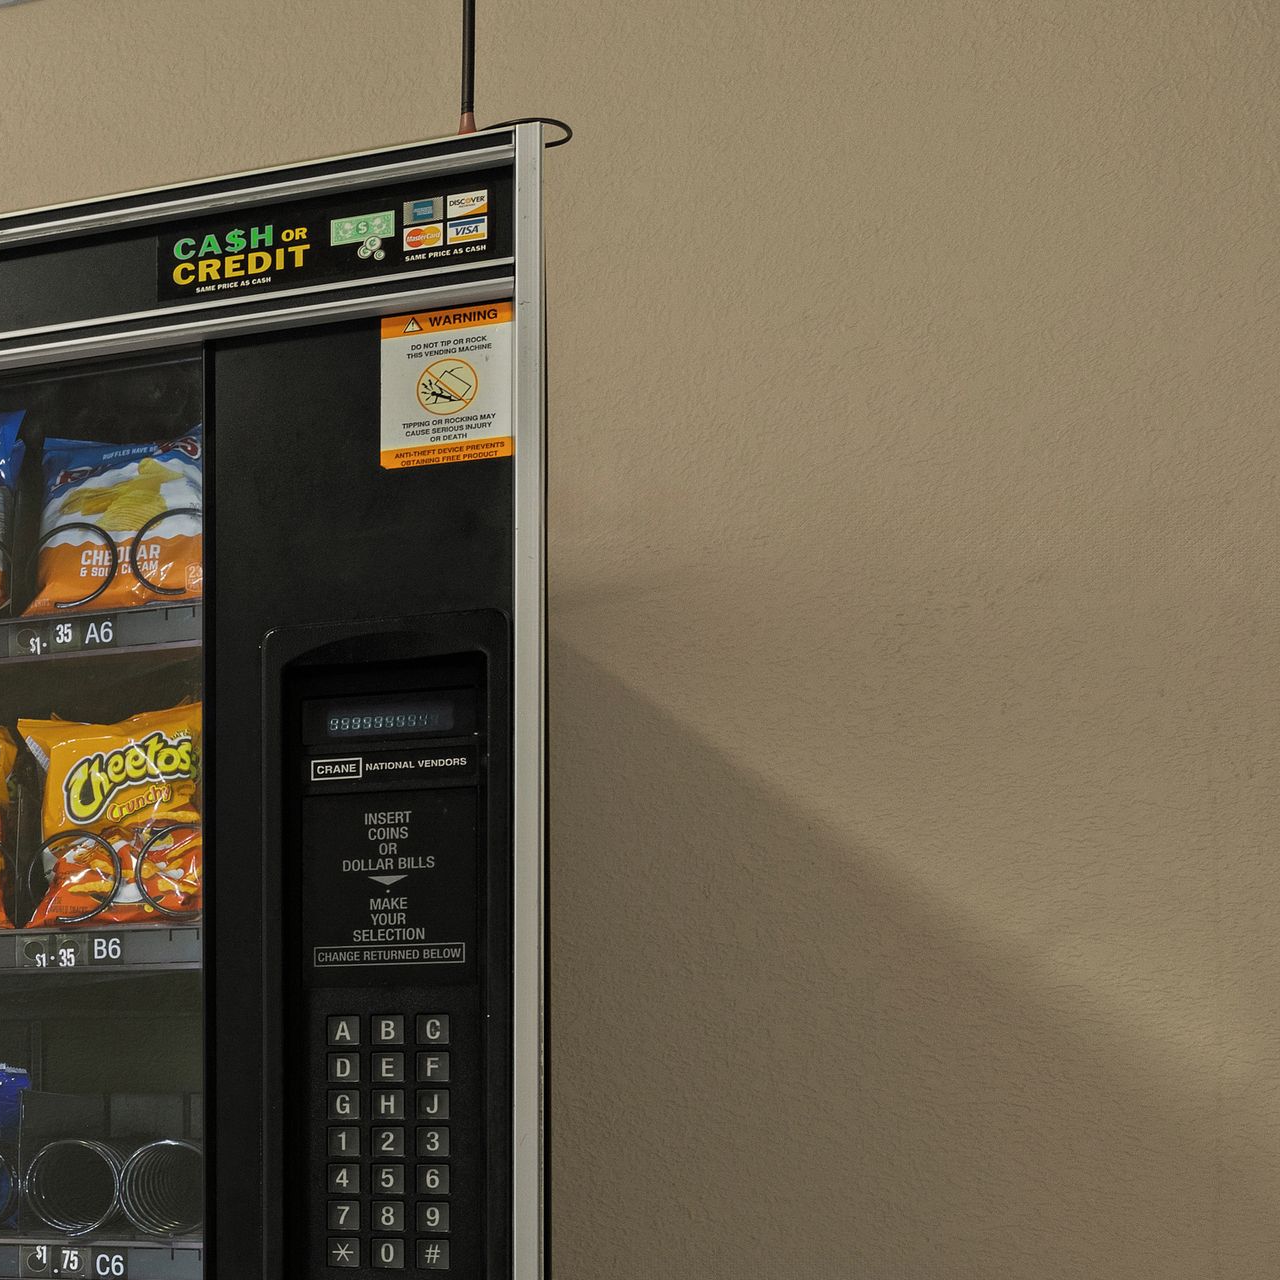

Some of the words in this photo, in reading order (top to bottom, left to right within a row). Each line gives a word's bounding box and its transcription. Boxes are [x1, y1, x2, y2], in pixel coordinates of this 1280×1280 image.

[449, 195, 485, 207] DISCOVER
[281, 227, 308, 243] OR
[406, 232, 440, 242] MasterCard
[455, 225, 480, 236] VISA
[405, 253, 427, 262] SAME
[428, 250, 451, 259] PRICE
[465, 244, 487, 253] CASH
[172, 244, 311, 286] CREDIT
[195, 285, 217, 294] SAME
[217, 282, 239, 291] PRICE
[240, 280, 251, 288] AS
[252, 277, 272, 286] CASH
[429, 308, 498, 327] WARNING
[465, 335, 487, 343] ROCK
[424, 348, 456, 357] VENDING
[458, 343, 492, 352] MACHINE
[402, 421, 430, 429] TIPPING
[444, 415, 478, 424] ROCKING
[405, 429, 430, 437] CAUSE
[432, 424, 464, 434] SERIOUS
[465, 422, 492, 430] INJURY
[443, 433, 467, 441] DEATH
[395, 449, 437, 459] ANTI-THEFT
[438, 446, 464, 454] DEVICE
[466, 442, 504, 451] PREVENTS
[401, 457, 440, 466] OBTAINING
[463, 450, 498, 459] PRODUCT
[84, 621, 113, 644] A6
[316, 763, 357, 775] CRANE
[365, 761, 415, 771] NATIONAL
[417, 757, 467, 767] VENDORS
[64, 733, 191, 822] Cheetos
[106, 784, 172, 823] Crunchy
[364, 811, 412, 825] INSERT
[368, 826, 409, 841] COINS
[379, 843, 397, 855] OR
[342, 858, 394, 872] DOLLAR
[398, 856, 435, 869] BILLS
[369, 897, 408, 911] MAKE
[371, 912, 406, 926] YOUR
[353, 927, 425, 942] SELECTION
[94, 939, 121, 959] B6
[317, 950, 360, 962] CHANGE
[363, 949, 420, 961] RETURNED
[423, 947, 461, 959] BELOW
[96, 1254, 123, 1275] C6
